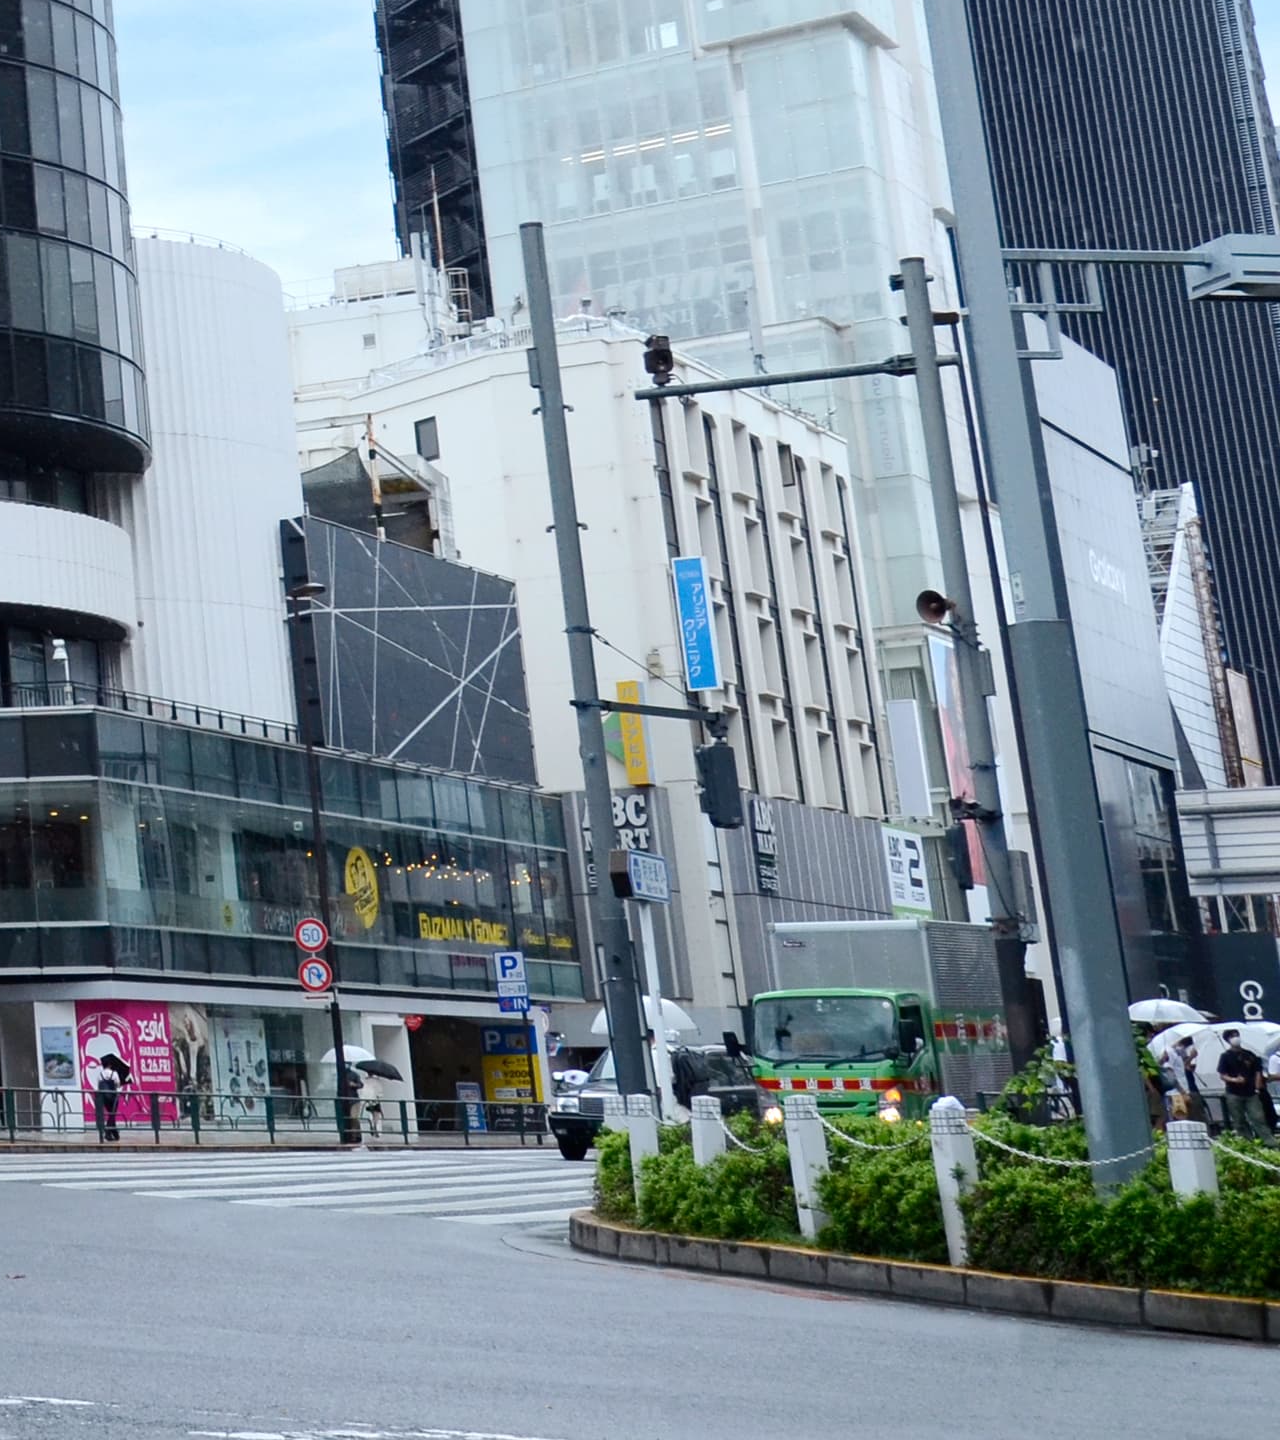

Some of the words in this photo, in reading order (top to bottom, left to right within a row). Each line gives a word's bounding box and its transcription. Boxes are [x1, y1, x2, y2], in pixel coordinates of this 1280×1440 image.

[1088, 548, 1128, 605] Galaxy
[754, 799, 776, 833] ABC
[904, 838, 925, 889] 2
[301, 928, 321, 943] 50
[418, 913, 465, 942] GUZMAN
[500, 956, 518, 978] P
[513, 998, 528, 1010] IN
[483, 1030, 501, 1052] P
